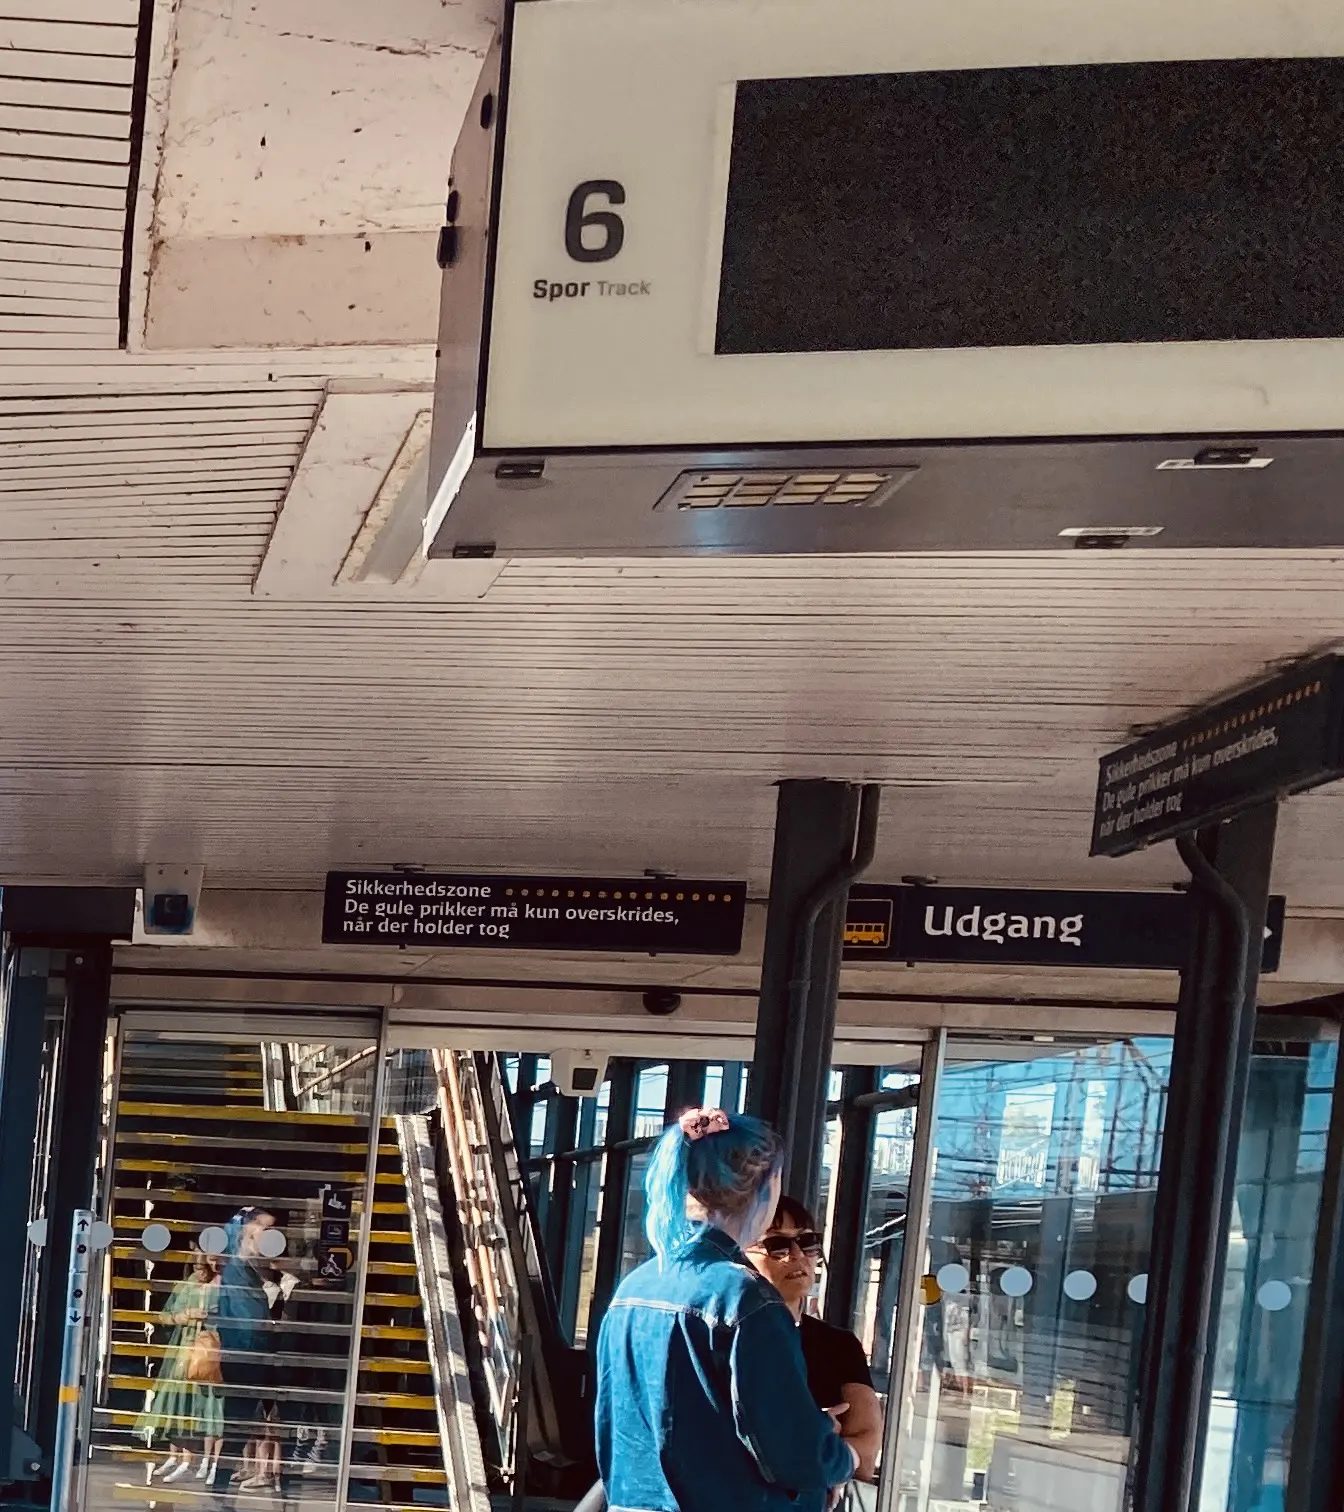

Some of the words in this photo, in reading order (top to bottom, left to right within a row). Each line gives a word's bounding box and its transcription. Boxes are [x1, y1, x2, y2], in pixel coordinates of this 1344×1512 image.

[565, 179, 625, 262] 6
[533, 279, 590, 302] Spor
[597, 280, 651, 296] Track
[346, 879, 492, 898] Sikkerhedszone
[345, 899, 369, 914] De
[375, 900, 414, 917] gule
[420, 901, 486, 918] prikker
[490, 902, 518, 918] må
[525, 904, 559, 920] kun
[565, 906, 679, 926] overskrides,
[343, 916, 373, 932] når
[378, 918, 408, 933] der
[414, 919, 474, 935] holder
[479, 922, 510, 939] tog
[924, 905, 1084, 946] Udgang
